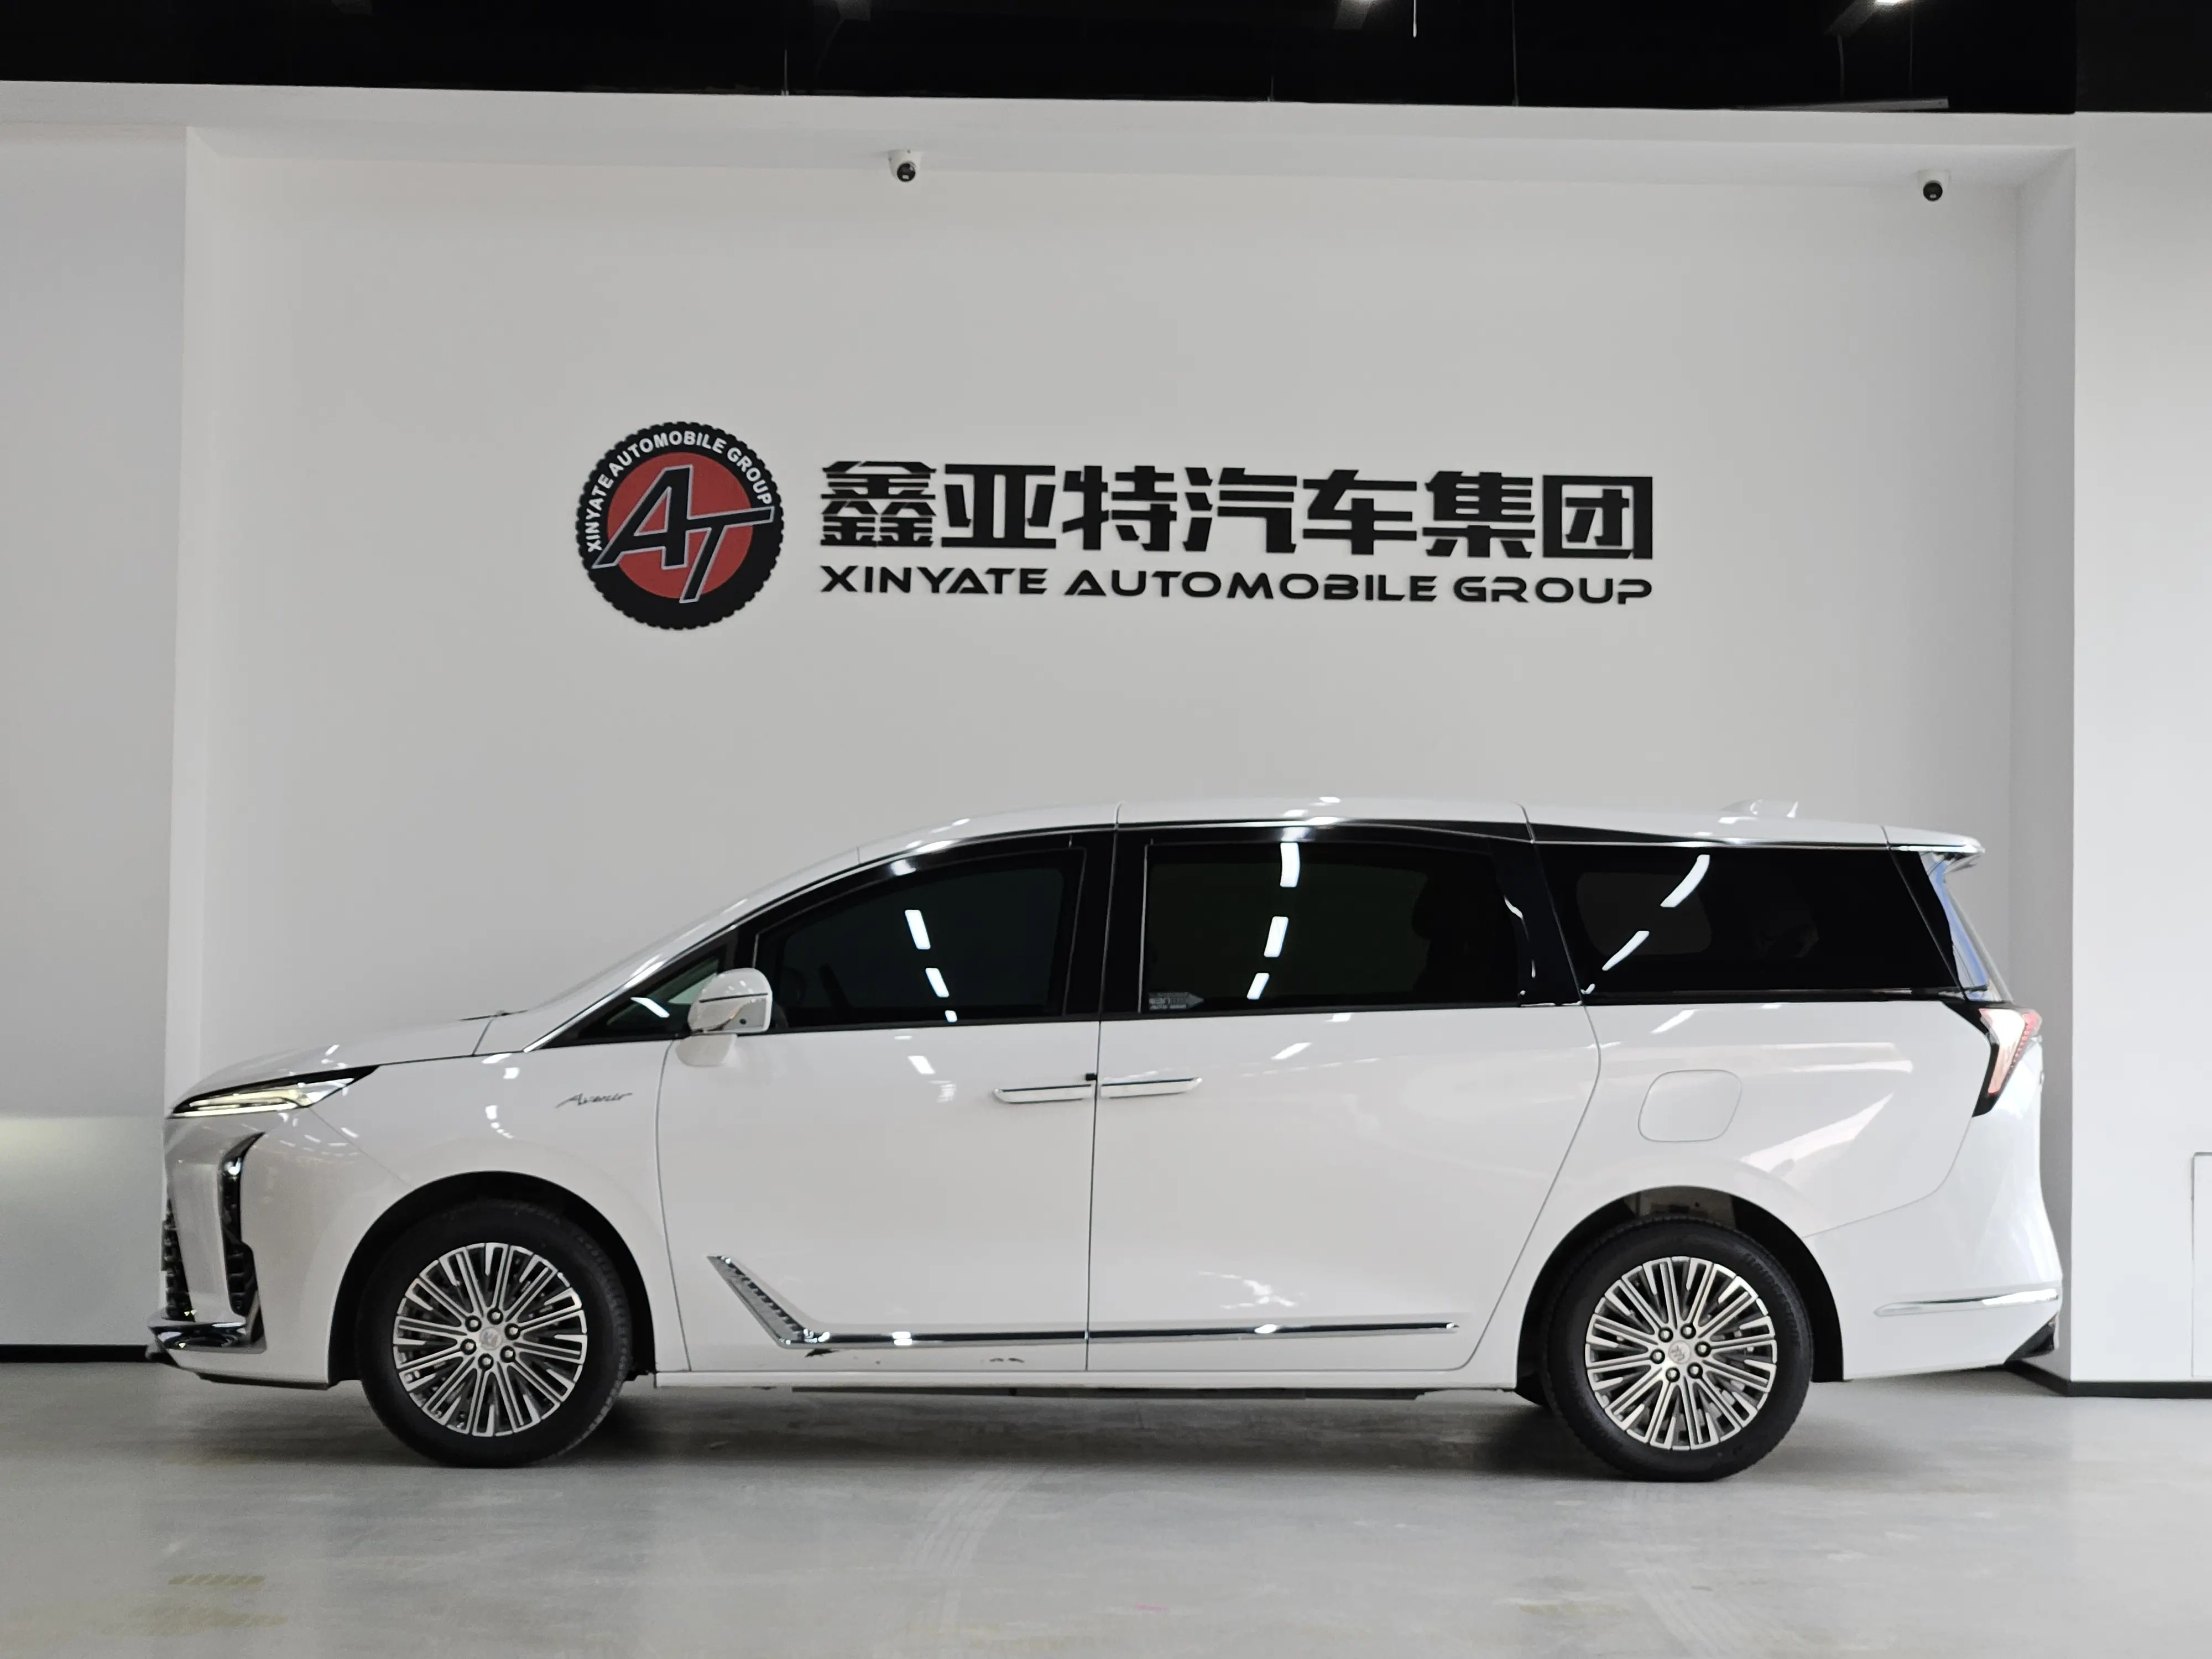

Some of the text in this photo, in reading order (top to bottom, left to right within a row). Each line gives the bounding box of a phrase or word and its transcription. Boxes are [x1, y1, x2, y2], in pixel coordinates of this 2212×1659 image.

[584, 430, 773, 552] XINYATE AUTOMOBILE GROUP
[820, 461, 1653, 560] 鑫亚特汽车集团
[820, 565, 1653, 605] XINYATE AUTOMOBILE GROUP
